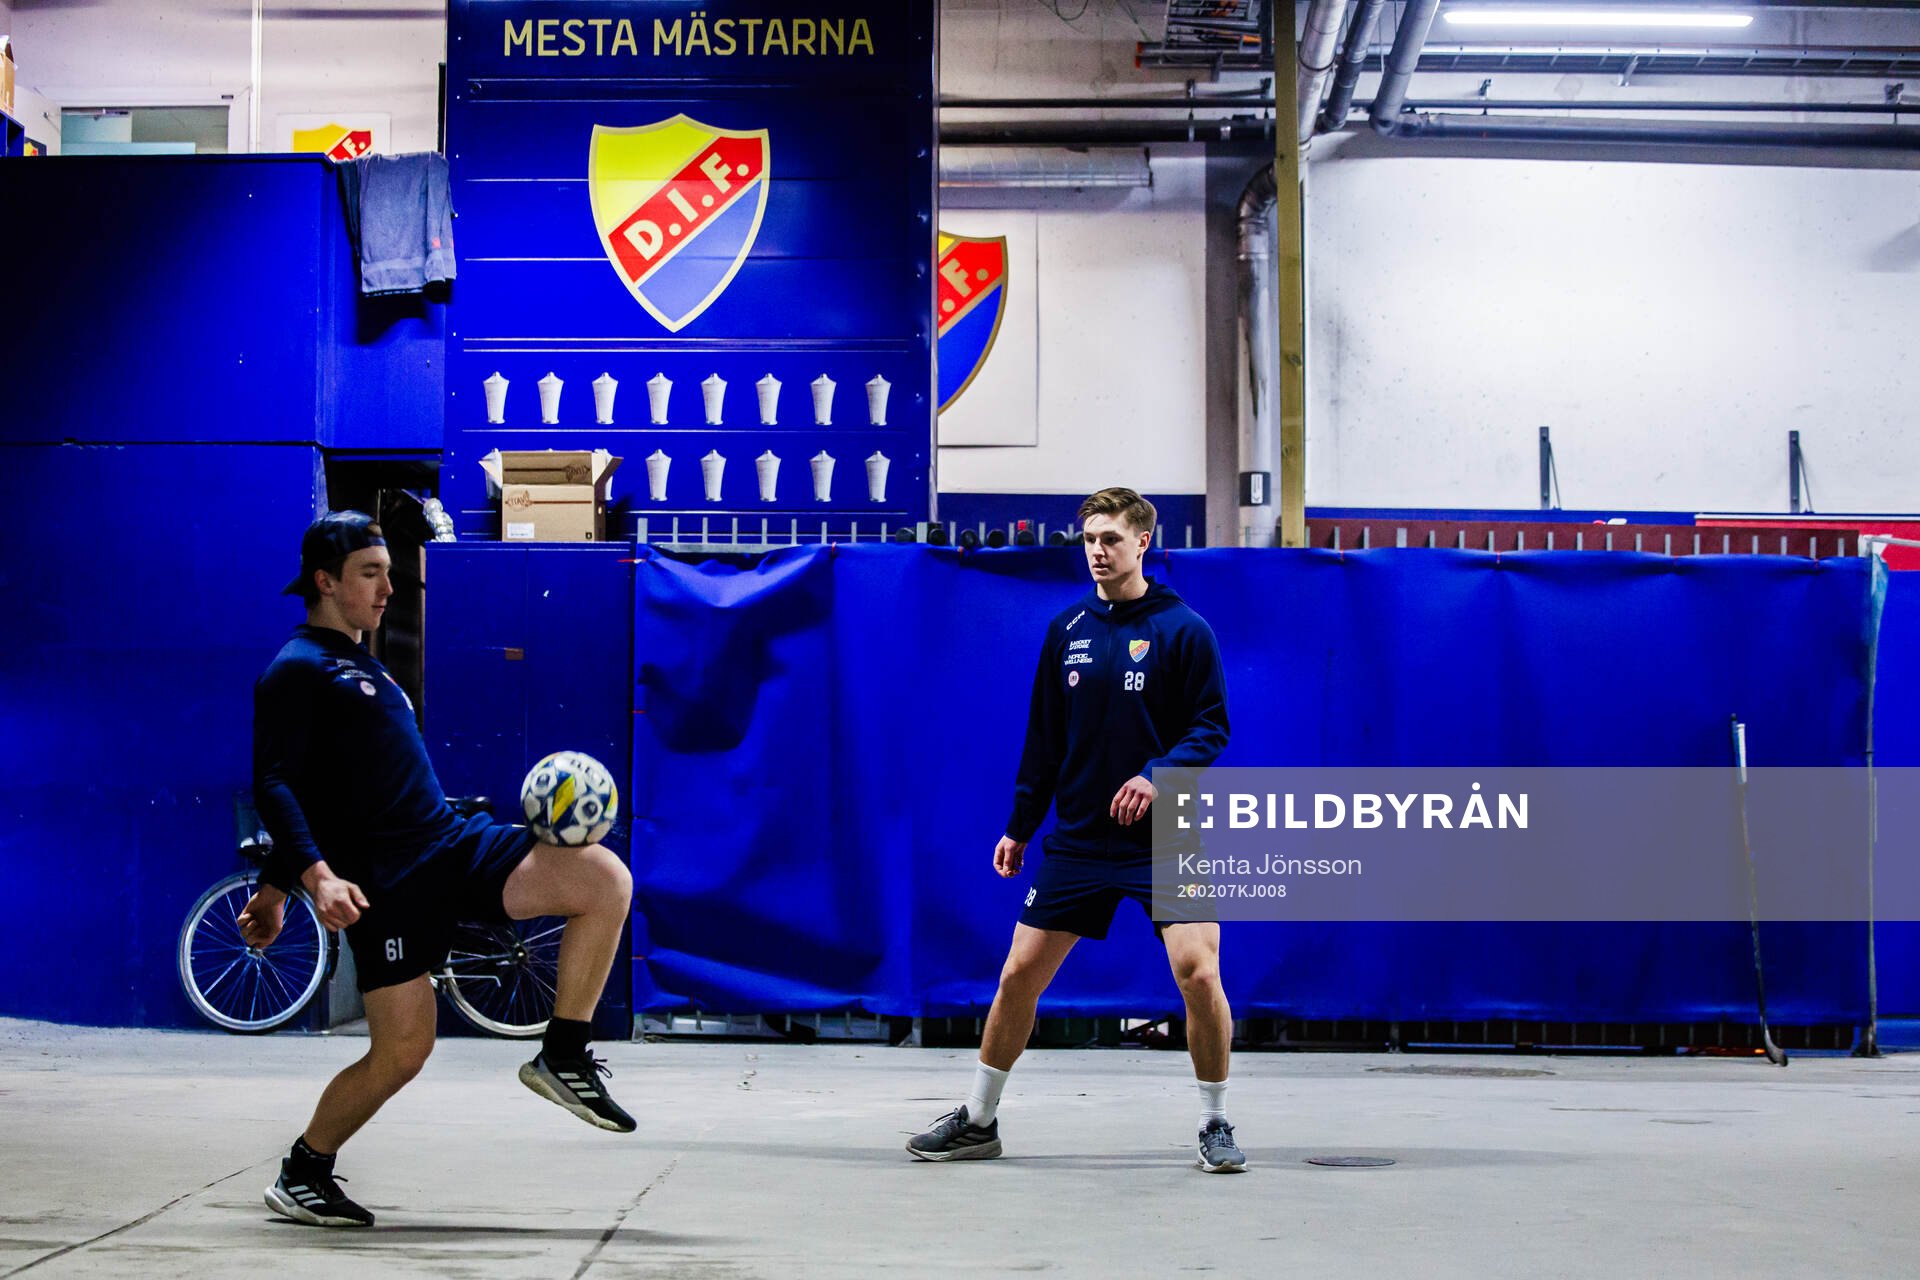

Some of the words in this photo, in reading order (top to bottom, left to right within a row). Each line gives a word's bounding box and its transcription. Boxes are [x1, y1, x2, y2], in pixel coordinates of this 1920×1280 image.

[504, 19, 638, 57] MESTA
[653, 11, 875, 57] MÄSTARNA
[622, 152, 750, 262] D.I.F.
[1066, 610, 1085, 630] CCM
[1064, 657, 1093, 666] WELLNESS
[1124, 671, 1145, 691] 28
[385, 937, 404, 962] 61
